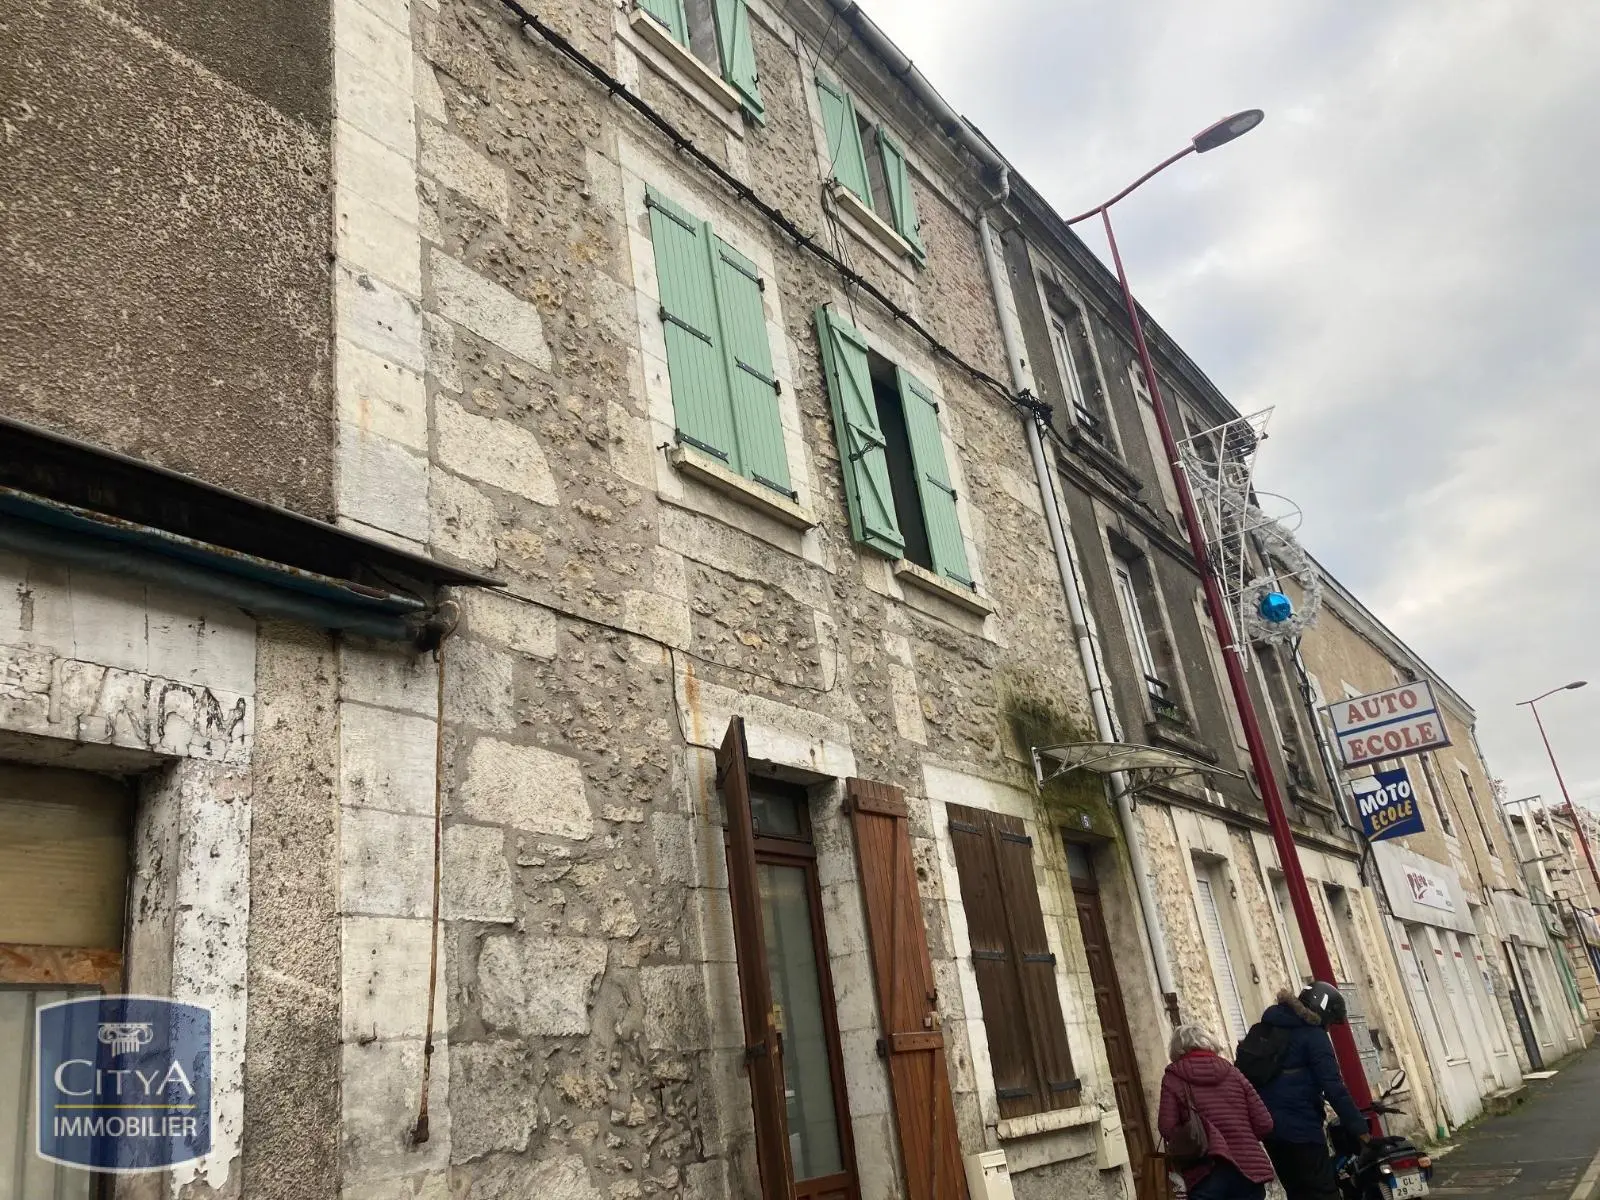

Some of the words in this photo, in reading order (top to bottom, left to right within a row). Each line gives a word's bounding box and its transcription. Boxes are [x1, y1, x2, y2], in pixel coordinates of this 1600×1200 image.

[1347, 689, 1417, 724] AUTO
[1348, 721, 1437, 760] ECOLE
[1358, 780, 1411, 816] MOTO
[1370, 800, 1413, 830] ECOLE
